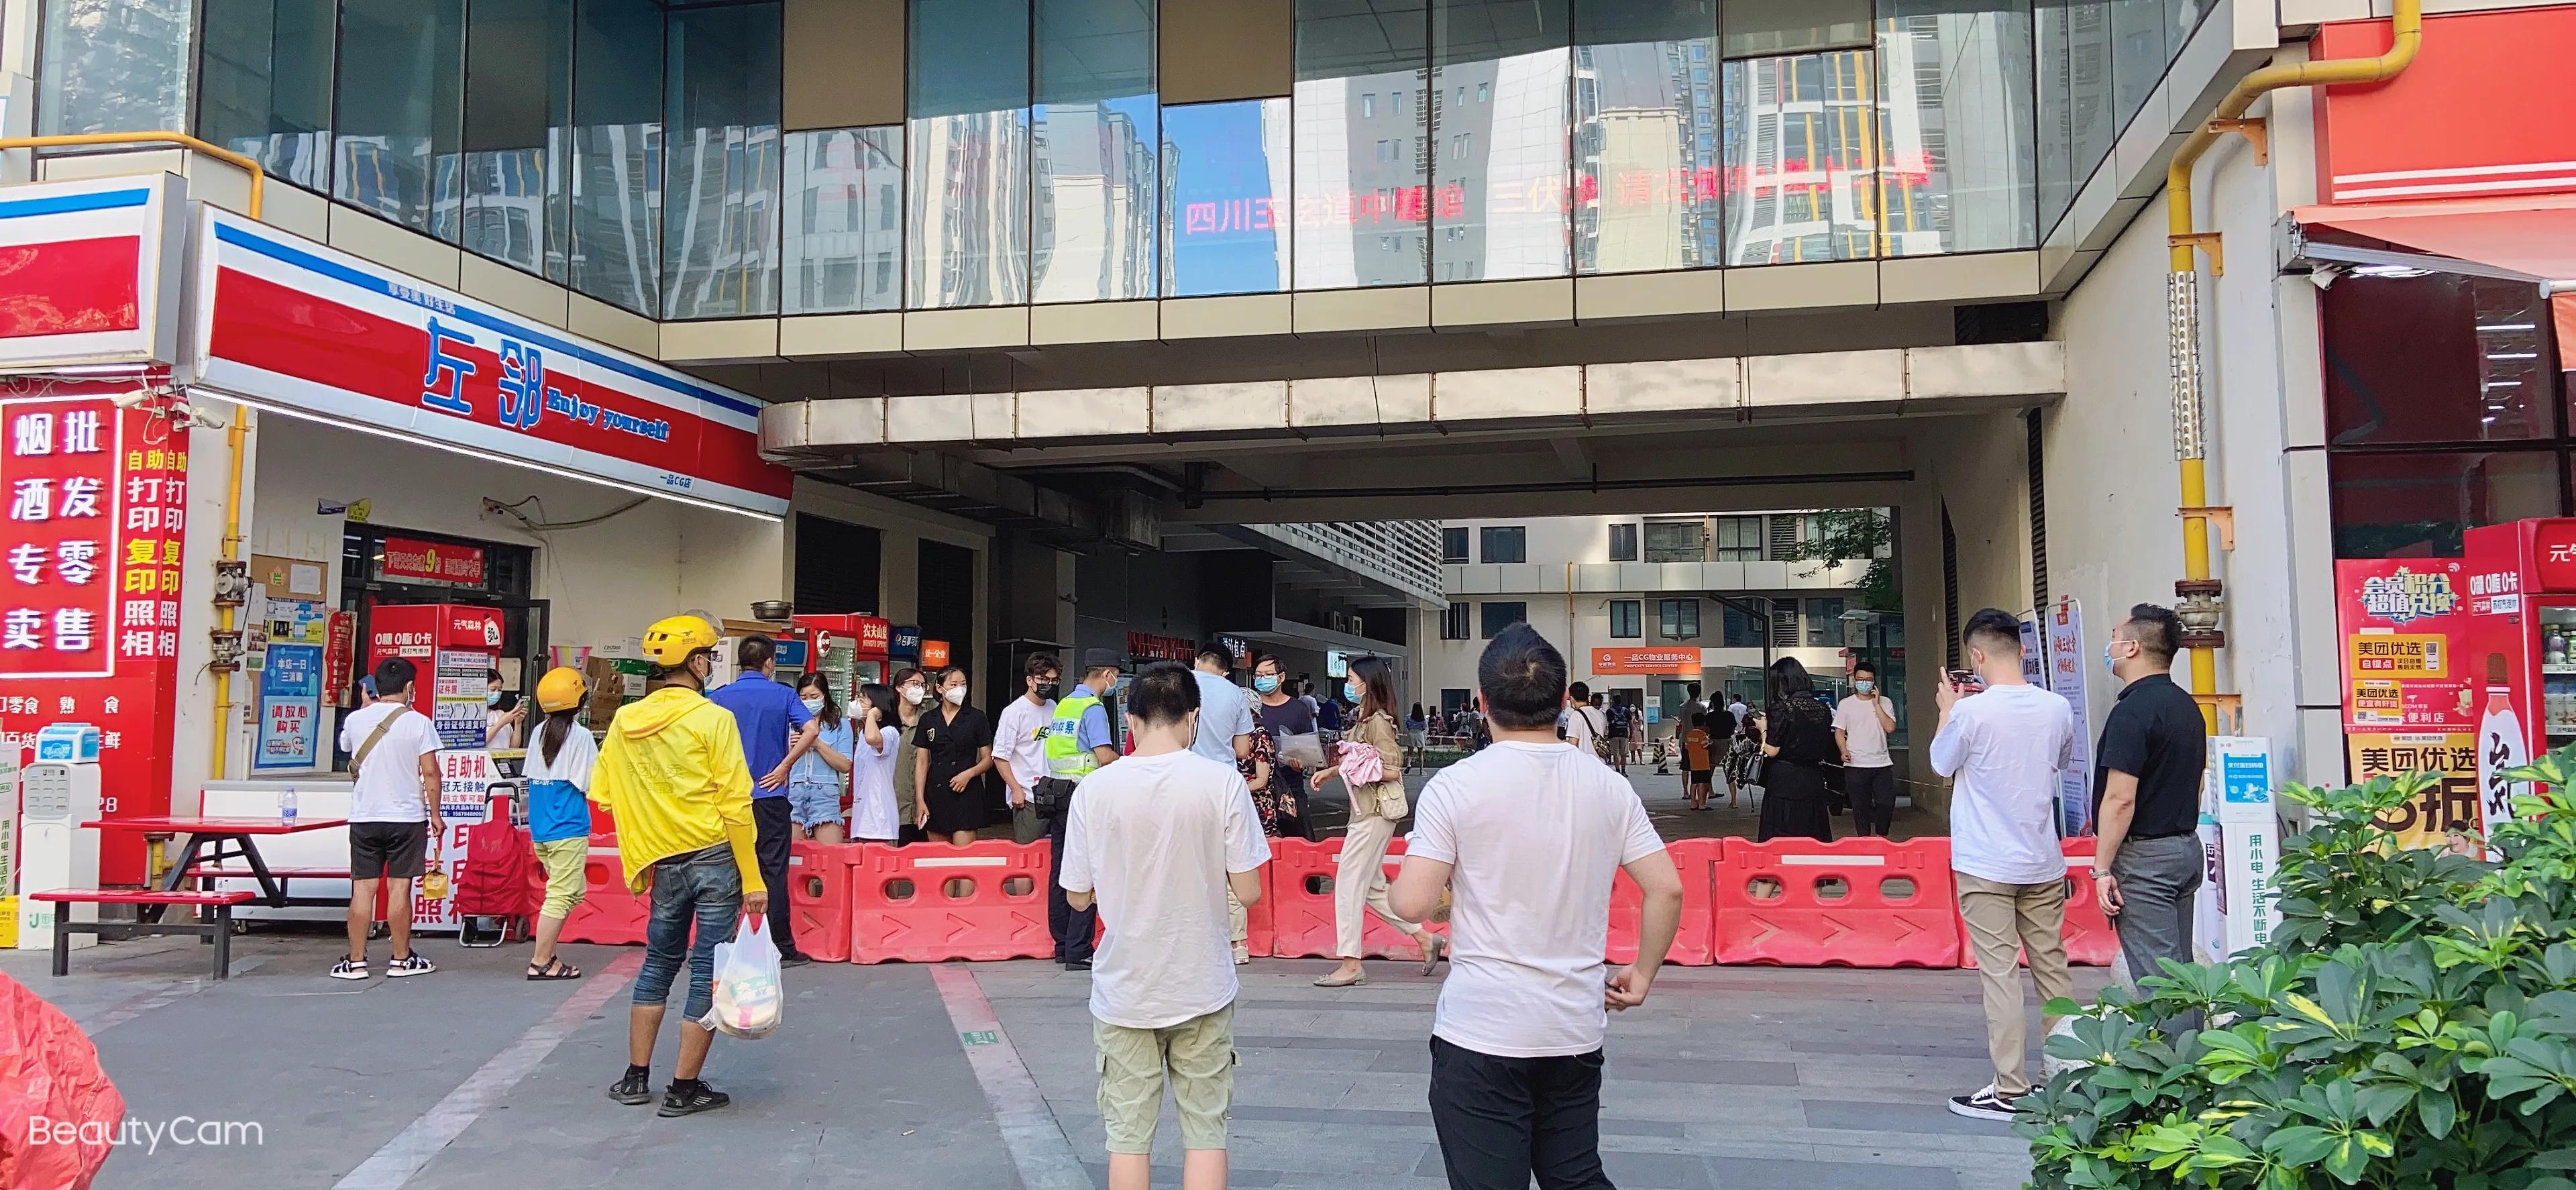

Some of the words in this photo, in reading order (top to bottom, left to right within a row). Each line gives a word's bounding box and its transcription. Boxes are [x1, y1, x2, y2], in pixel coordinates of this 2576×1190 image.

[547, 386, 600, 426] Enjoy
[603, 408, 669, 442] yourself
[127, 449, 164, 471] 自助
[166, 449, 187, 472] 自助
[660, 474, 692, 488] 一品CG店
[3, 412, 54, 650] 烟酒专卖
[54, 409, 101, 651] 批发零售
[2363, 573, 2451, 595] 会员积分
[2368, 593, 2451, 618] 超值兑换
[453, 619, 482, 631] 元气森林
[415, 633, 432, 645] 0卡
[2358, 642, 2421, 655] 美团优选
[278, 658, 307, 669] 本店一日
[1624, 653, 1694, 661] 一品CG物业服务中心
[2362, 659, 2392, 669] 自提点
[2357, 688, 2399, 698] 美团优选
[276, 720, 301, 734] 购买
[1065, 720, 1075, 734] 察
[2361, 747, 2475, 772] 美团优选
[442, 781, 485, 792] 冠无接触
[2249, 834, 2263, 873] 用小电
[2252, 878, 2267, 944] 生活不断电
